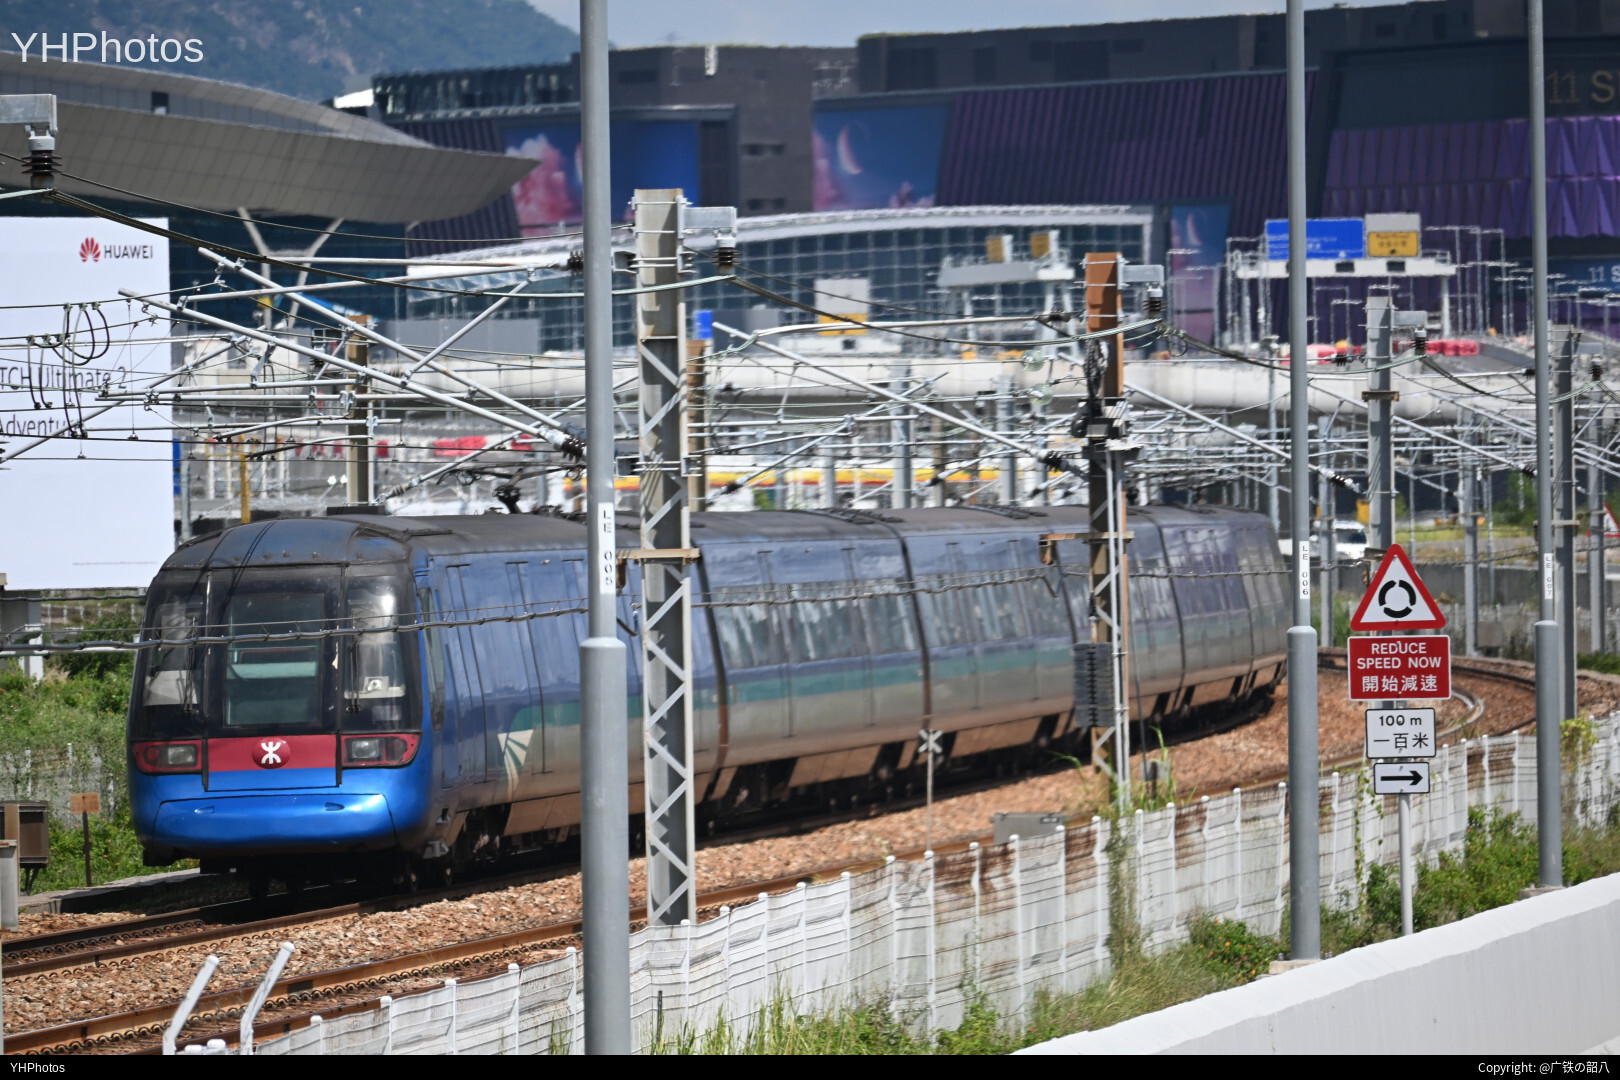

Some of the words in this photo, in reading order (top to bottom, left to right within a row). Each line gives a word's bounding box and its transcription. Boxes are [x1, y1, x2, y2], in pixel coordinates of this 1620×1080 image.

[1546, 69, 1580, 104] 11
[103, 244, 154, 259] HUAWEI
[38, 365, 111, 391] Ultmate
[117, 366, 127, 389] 2
[1371, 642, 1427, 655] REDUCE
[1357, 657, 1401, 669] SPEED
[1408, 656, 1441, 669] NOW
[1362, 674, 1438, 692] 開始減速
[1379, 715, 1405, 726] 100
[1410, 717, 1422, 726] m
[1373, 732, 1429, 749] 一百米
